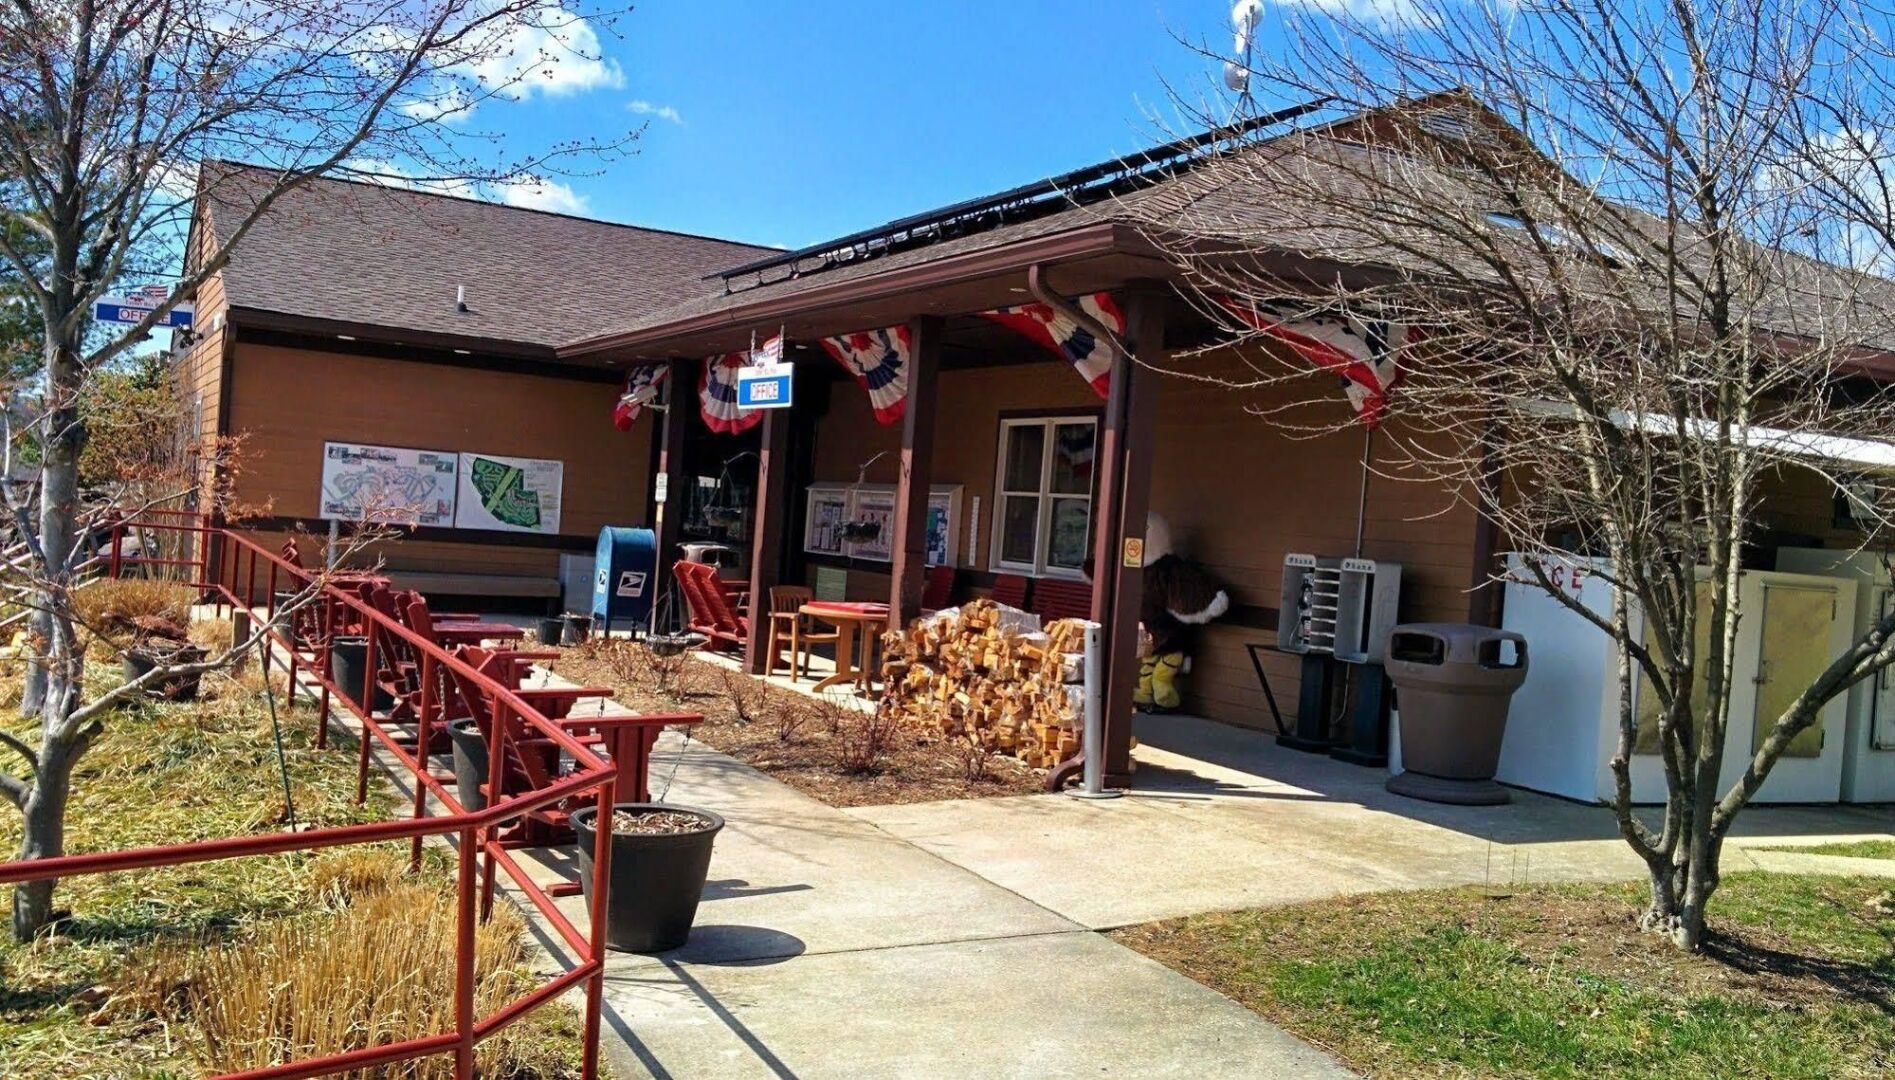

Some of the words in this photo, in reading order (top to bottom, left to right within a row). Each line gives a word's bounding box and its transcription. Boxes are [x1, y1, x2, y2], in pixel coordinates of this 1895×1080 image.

[120, 308, 169, 323] OFFE
[751, 382, 778, 399] OFFICE
[1535, 560, 1583, 588] CE
